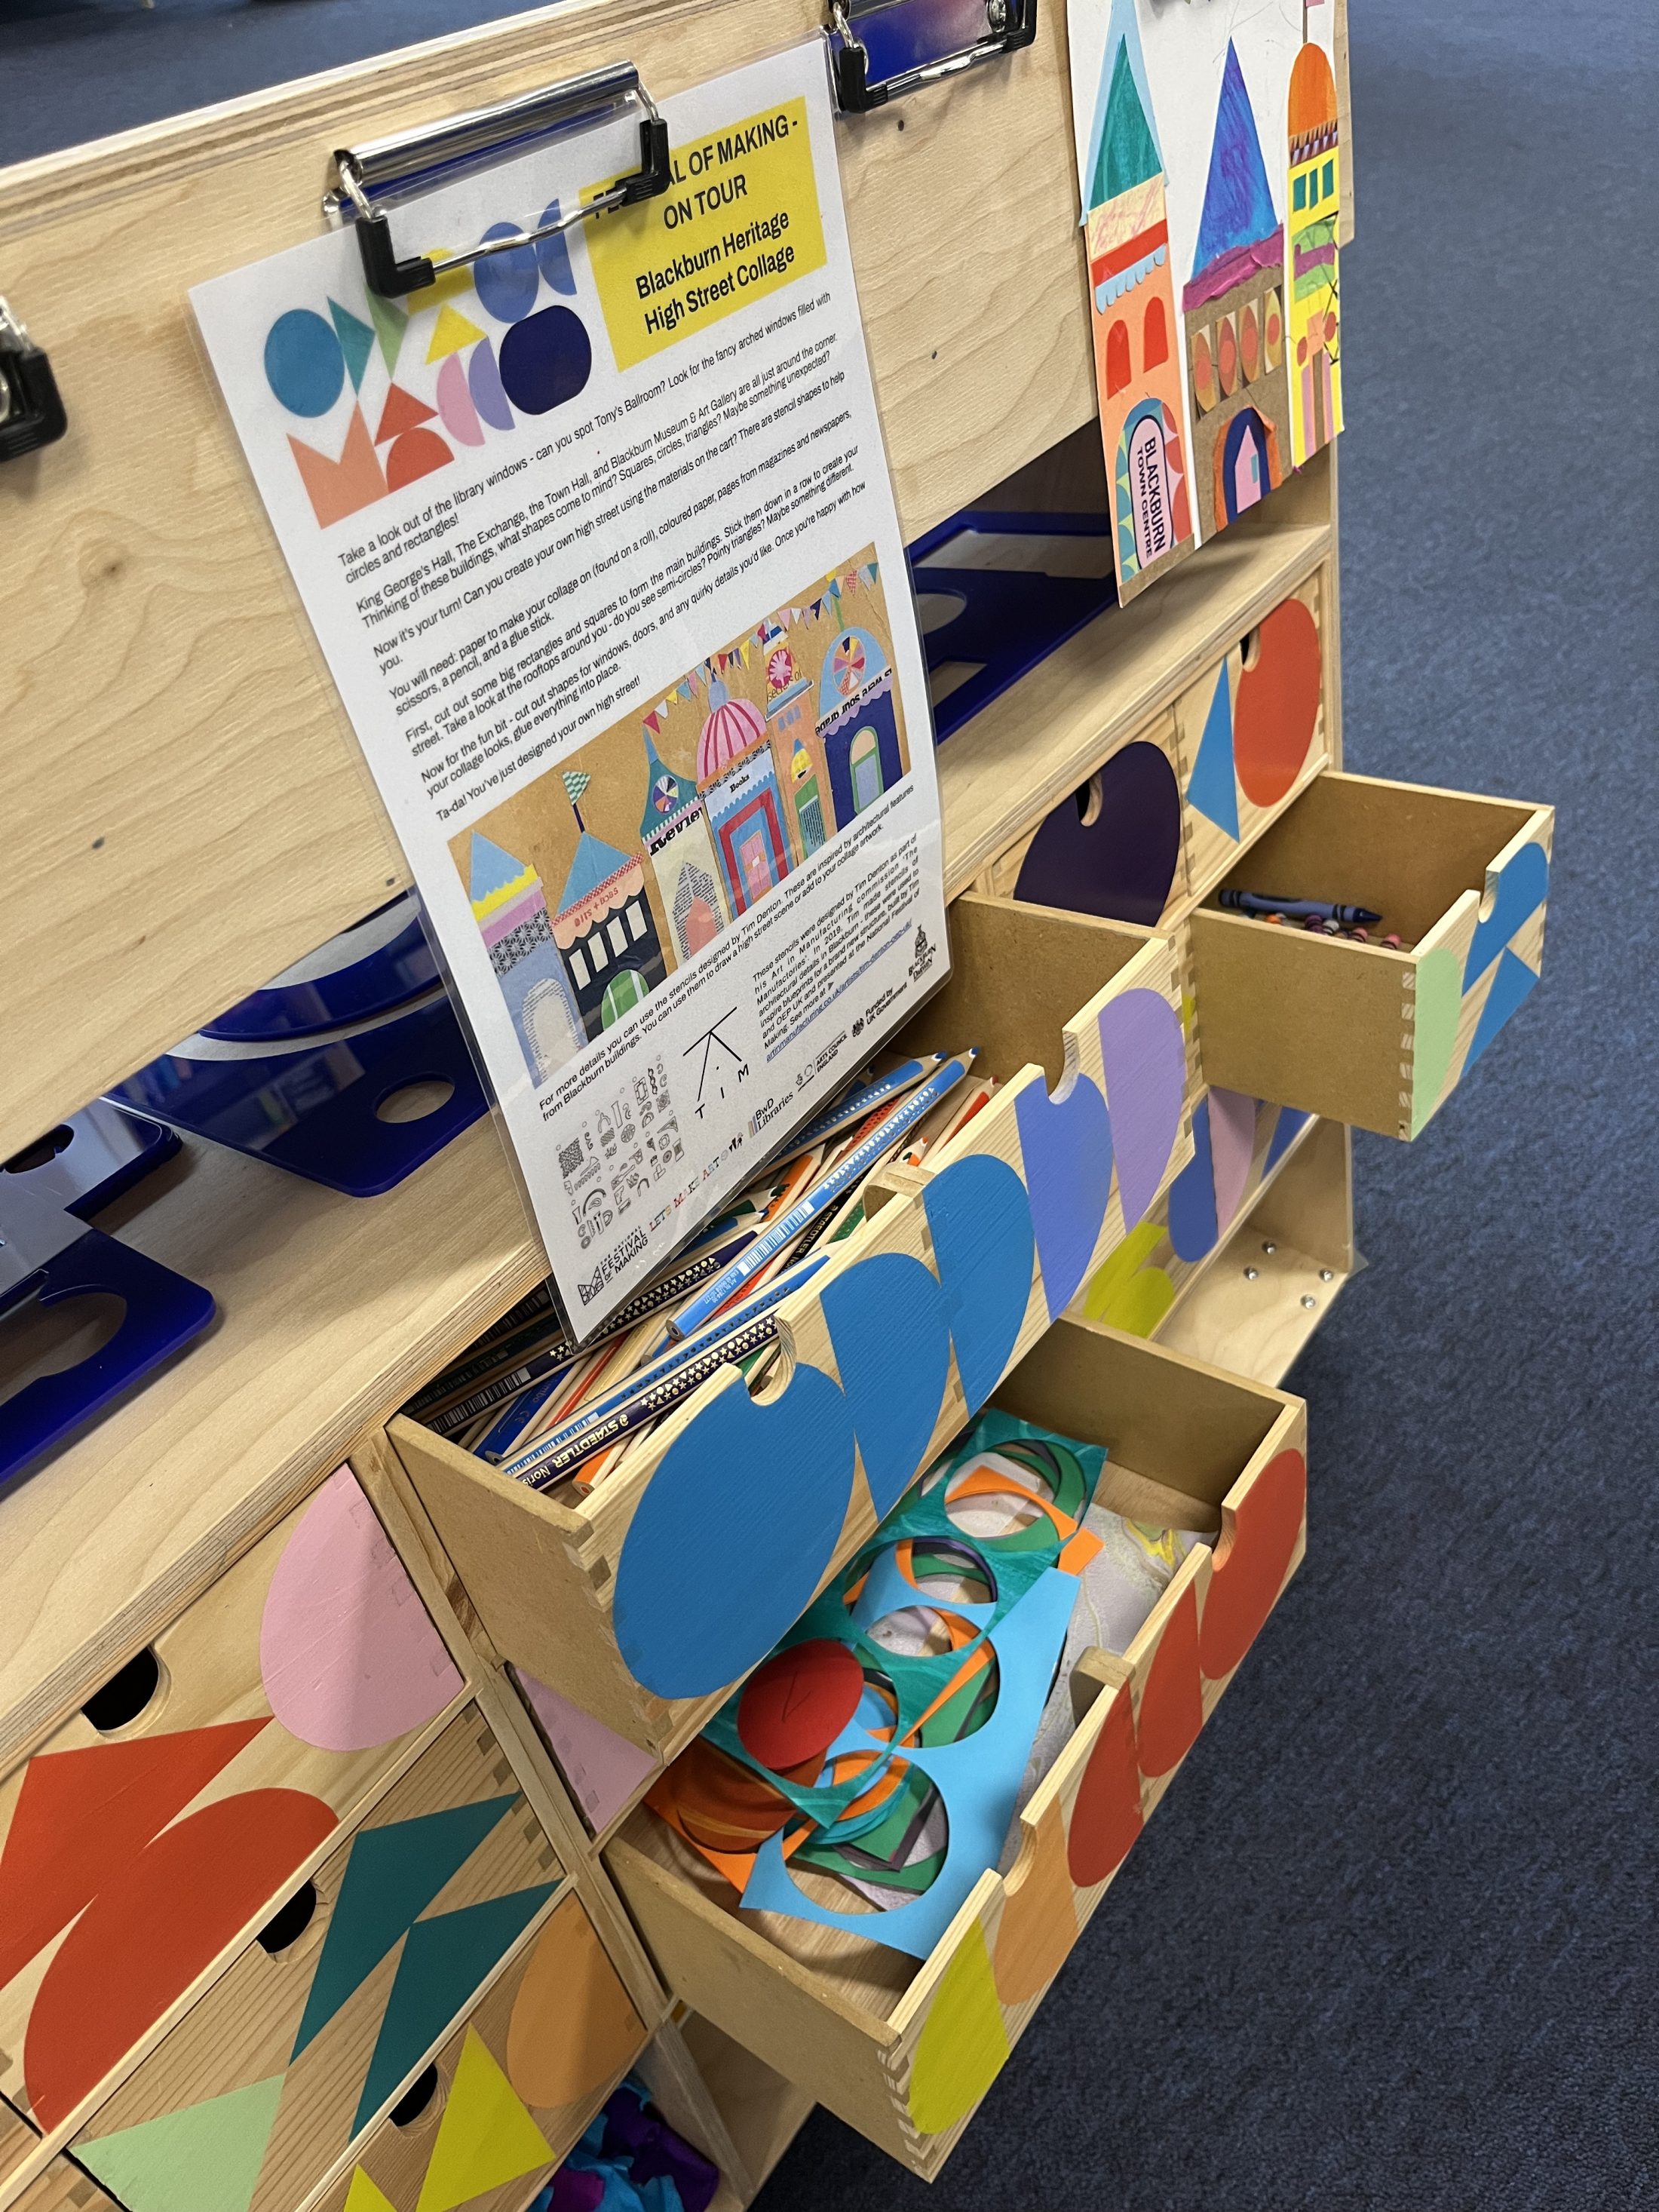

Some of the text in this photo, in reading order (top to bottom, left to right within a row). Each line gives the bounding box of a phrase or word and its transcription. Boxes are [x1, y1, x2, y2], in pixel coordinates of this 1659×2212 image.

[688, 144, 713, 176] OF
[716, 114, 789, 165] MAKING
[664, 197, 693, 229] ON
[693, 173, 748, 215] TOUR
[635, 212, 789, 299] Blackburn Heritage
[644, 246, 795, 335] High Street Collage
[337, 546, 366, 566] Take
[367, 540, 377, 552] a
[376, 525, 402, 546] look
[402, 514, 421, 533] out
[422, 505, 434, 522] of
[434, 499, 452, 515] the
[452, 481, 484, 505] library
[486, 458, 528, 487] windows
[535, 443, 554, 460] can
[554, 434, 572, 453] you
[573, 420, 594, 440] spot
[624, 379, 666, 413] Ballroom?
[667, 369, 689, 388] Look
[688, 363, 700, 376] for
[701, 355, 715, 370] the
[715, 343, 737, 362] fancy
[738, 326, 764, 350] arched
[764, 311, 797, 335] windows
[797, 298, 815, 317] filled
[815, 291, 831, 307] with
[355, 591, 384, 613] King
[431, 549, 456, 571] Hall,
[455, 538, 477, 556] The
[476, 511, 529, 545] Exchange,
[528, 500, 545, 515] the
[544, 485, 571, 505] Town
[570, 472, 592, 491] Hall,
[593, 460, 610, 480] and
[609, 438, 653, 469] Blackburn
[652, 417, 689, 444] Museum
[698, 403, 710, 419] Art
[710, 389, 737, 411] Gallery
[738, 382, 751, 396] are
[751, 373, 761, 388] all
[760, 366, 775, 385] just
[775, 351, 801, 374] around
[801, 346, 814, 359] the
[814, 333, 838, 352] corner.
[360, 594, 410, 628] Thinking
[420, 572, 450, 596] these
[449, 547, 498, 579] buildings,
[496, 529, 522, 551] what
[521, 512, 555, 538] shapes
[555, 497, 581, 518] come
[590, 473, 617, 498] mind?
[618, 455, 657, 481] Squares,
[656, 438, 685, 459] circles,
[684, 413, 722, 443] triangles?
[722, 400, 748, 421] Maybe
[748, 376, 787, 406] something
[786, 349, 830, 384] unexpected?
[1137, 446, 1152, 559] TOWN CENTRE
[1144, 437, 1166, 553] BLACKBURN
[345, 511, 459, 584] circles and rectangles!
[395, 683, 441, 716] scissors,
[449, 655, 483, 685] pencil,
[482, 641, 501, 662] and
[509, 626, 529, 648] glue
[529, 611, 554, 632] stick.
[435, 793, 468, 821] Ta-da!
[498, 760, 517, 783] just
[517, 731, 557, 767] designed
[557, 719, 577, 742] your
[577, 707, 596, 726] own
[595, 694, 615, 713] high
[615, 674, 640, 700] street!
[729, 774, 750, 793] Books
[538, 1093, 554, 1110] For
[555, 1074, 578, 1097] more
[578, 1049, 606, 1076] details
[606, 1035, 622, 1054] you
[623, 1021, 639, 1039] can
[639, 1008, 654, 1024] use
[655, 996, 668, 1011] the
[668, 971, 698, 999] stencils
[698, 940, 731, 974] designed
[741, 920, 756, 935] Tim
[756, 898, 784, 924] Denton.
[784, 878, 805, 899] These
[805, 868, 817, 882] are
[817, 843, 842, 872] inspired
[816, 1053, 829, 1067] ARTS
[817, 1049, 839, 1073] ENGLAND
[754, 1097, 774, 1121] BwD
[756, 1091, 794, 1131] Libraries
[601, 1229, 646, 1275] FESTIVAL
[615, 1235, 649, 1274] MAKING
[795, 1211, 834, 1255] STAEDTLER
[522, 1419, 620, 1487] STAEDTLER Noris
